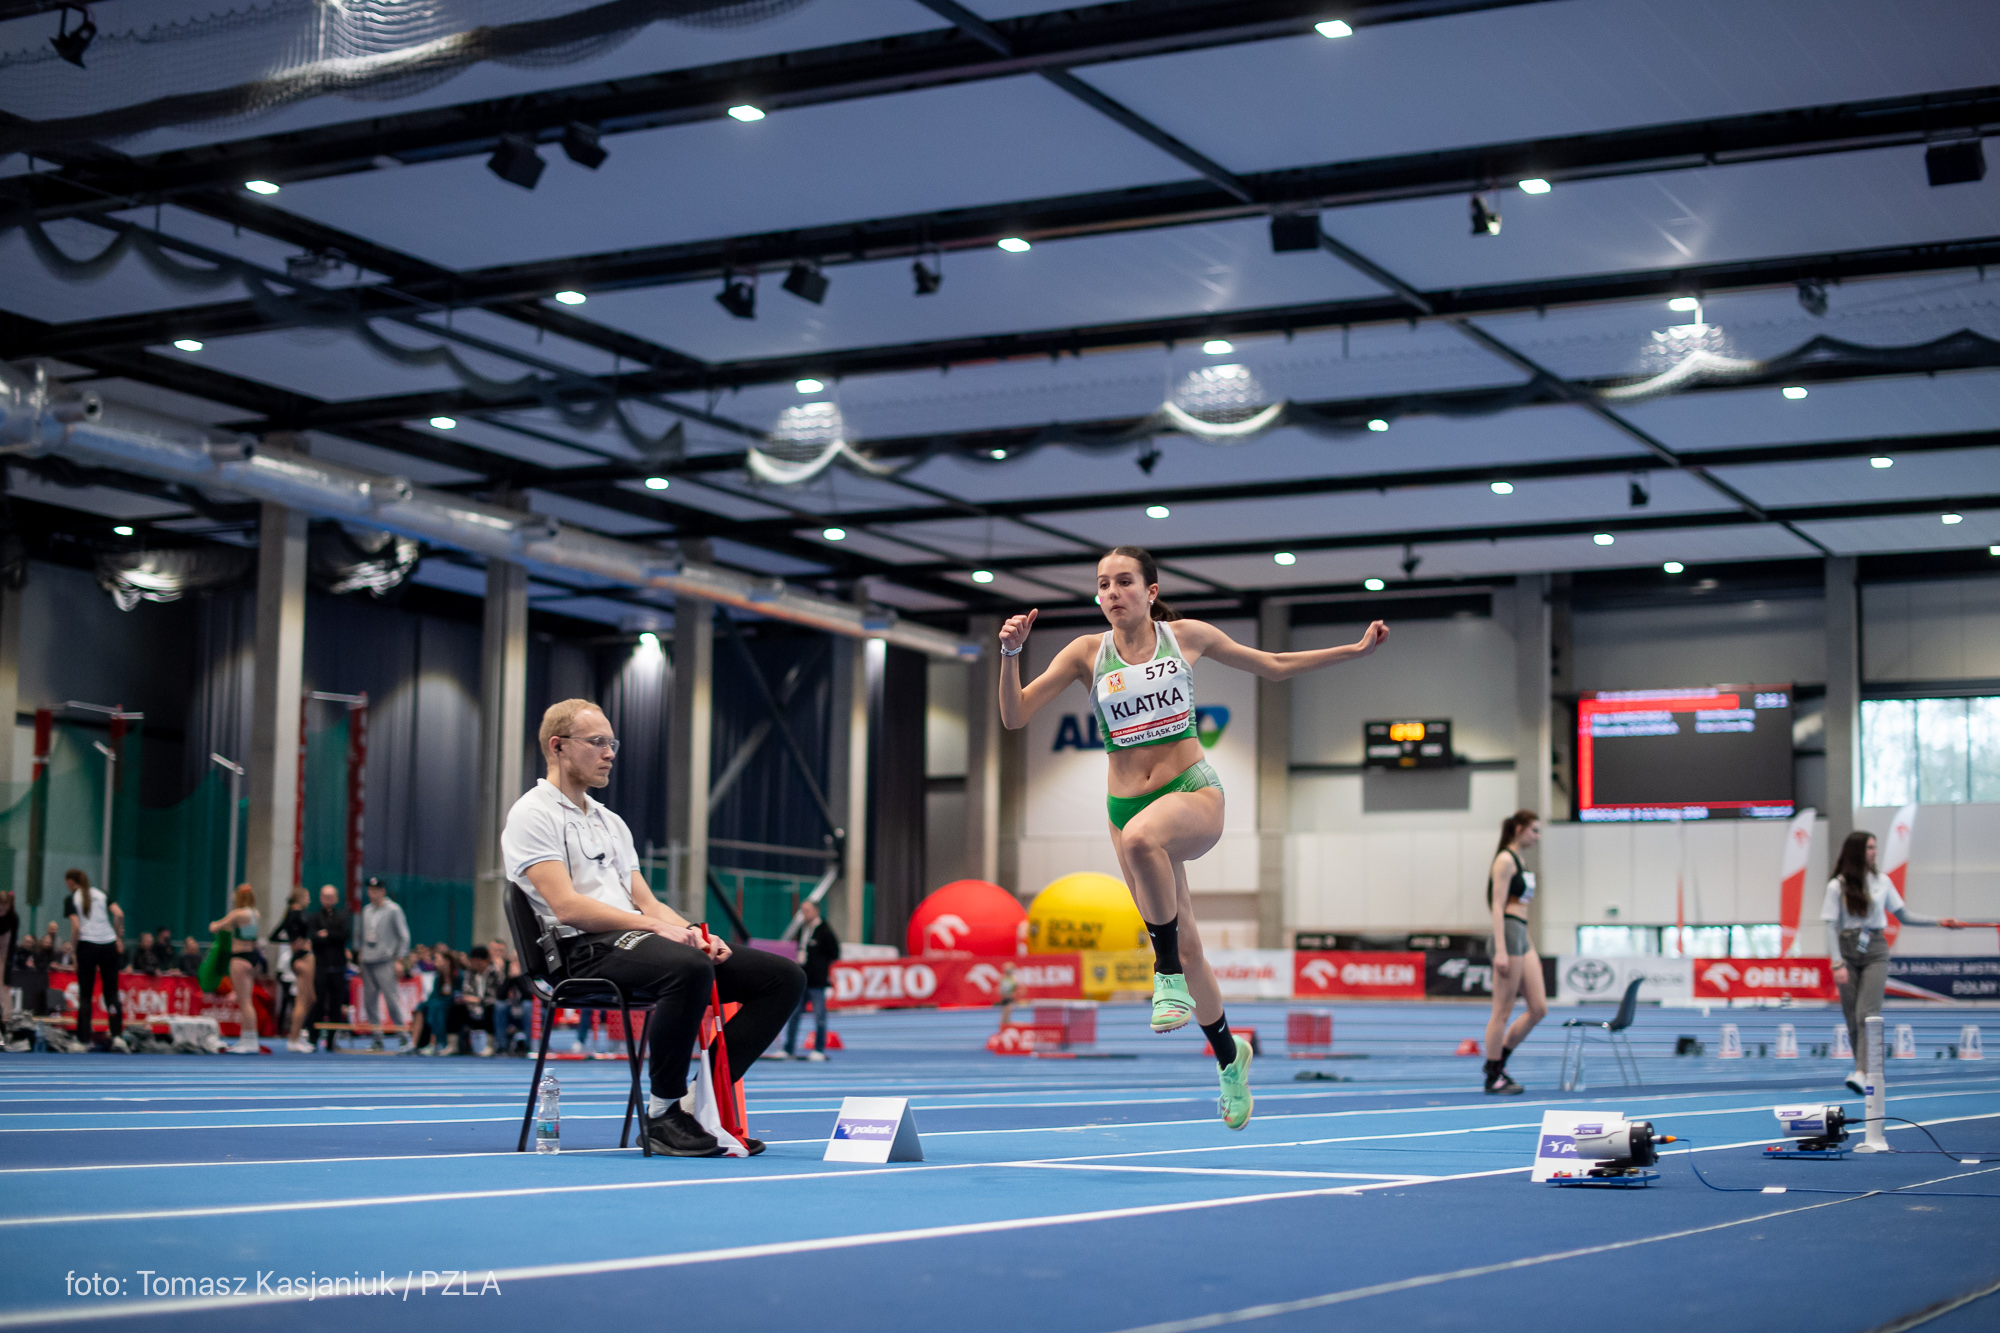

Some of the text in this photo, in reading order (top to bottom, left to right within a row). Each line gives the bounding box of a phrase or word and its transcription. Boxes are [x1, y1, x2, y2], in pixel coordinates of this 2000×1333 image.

[1145, 660, 1178, 681] 573
[1110, 686, 1184, 720] KLATKA
[1120, 733, 1145, 744] DOLNY
[1146, 727, 1171, 738] ŚLĄSK
[1340, 963, 1416, 987] ORLEN
[1743, 966, 1820, 988] ORLEN
[851, 1124, 892, 1136] polanik
